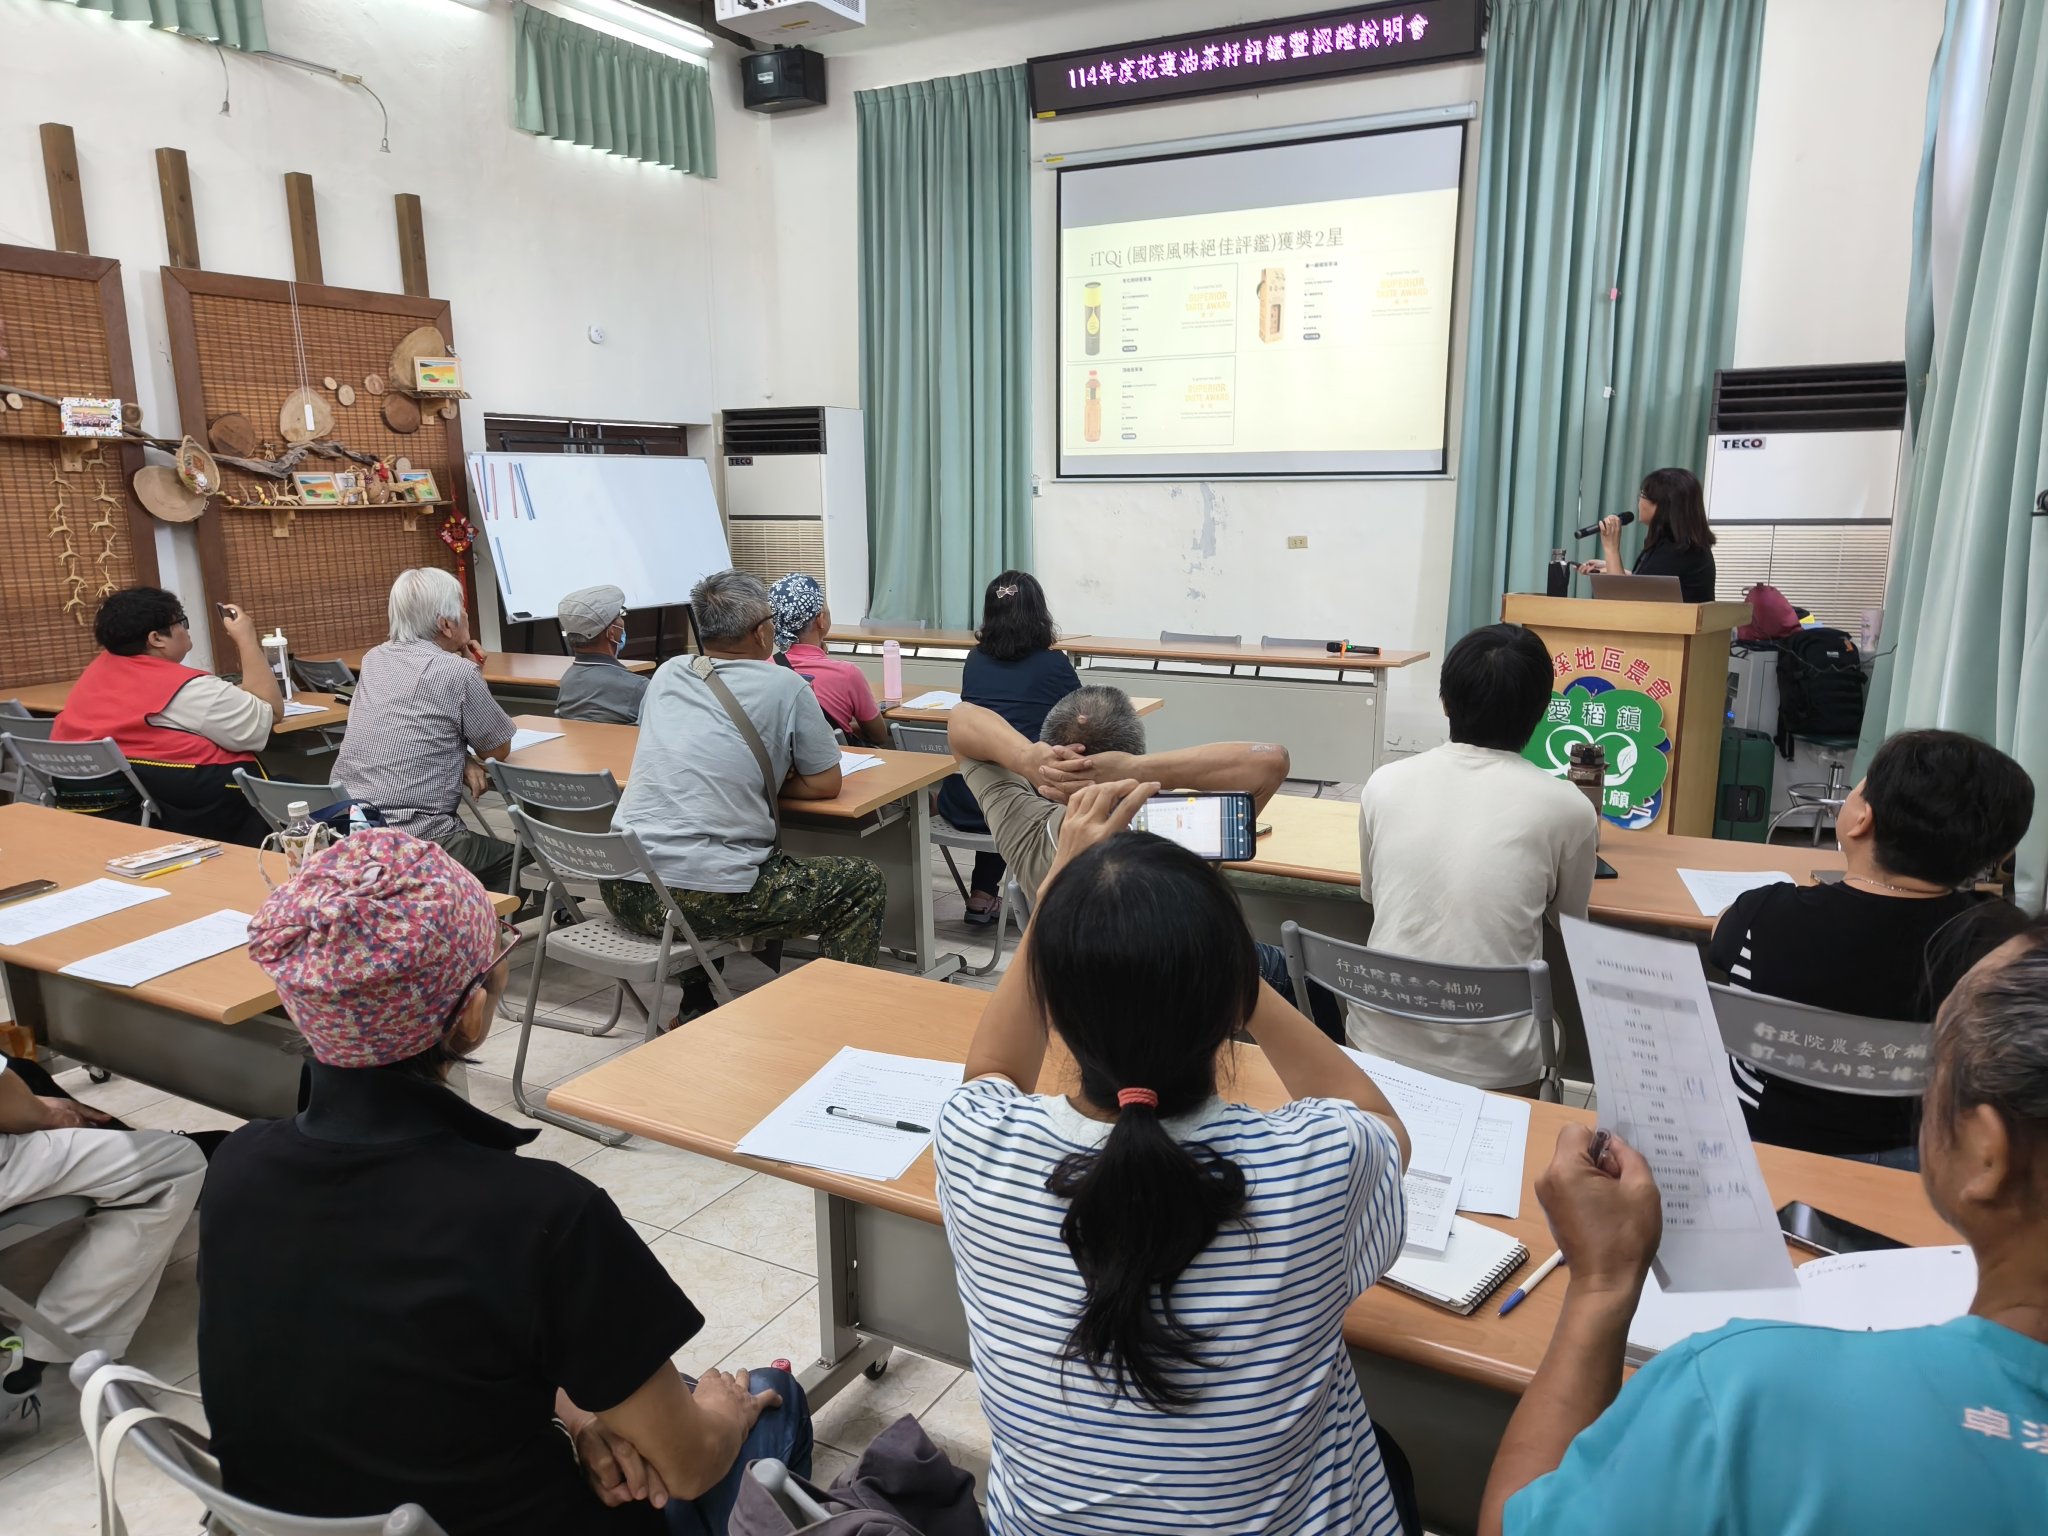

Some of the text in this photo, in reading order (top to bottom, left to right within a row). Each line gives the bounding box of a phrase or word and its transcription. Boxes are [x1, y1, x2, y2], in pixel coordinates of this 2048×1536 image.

[1090, 227, 1344, 268] iTQi (國際風味絕佳評鑑)獲獎2星
[1722, 438, 1763, 449] TECO
[729, 457, 752, 466] TECO
[1548, 698, 1642, 732] 愛稻鎮
